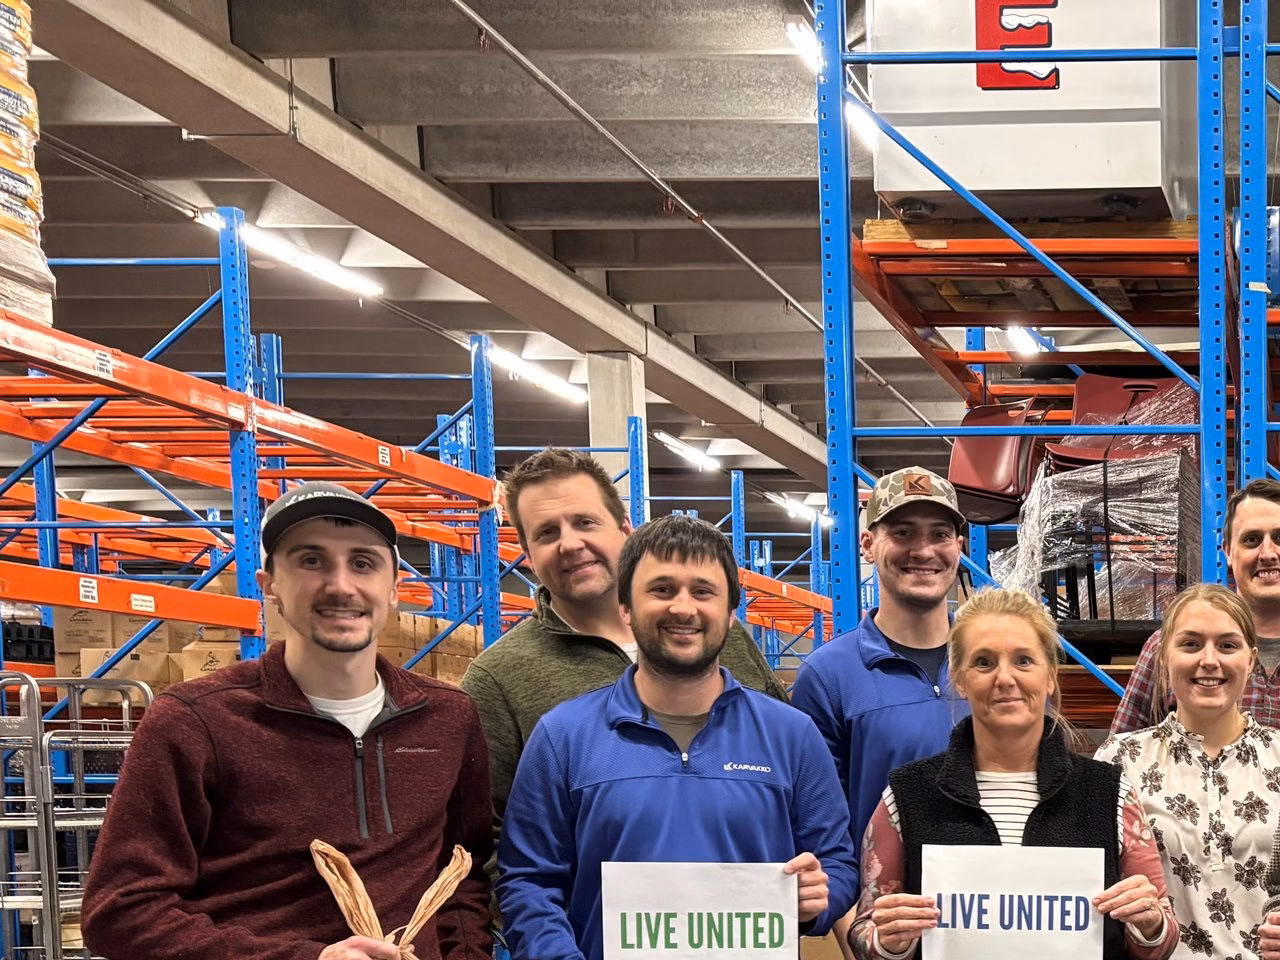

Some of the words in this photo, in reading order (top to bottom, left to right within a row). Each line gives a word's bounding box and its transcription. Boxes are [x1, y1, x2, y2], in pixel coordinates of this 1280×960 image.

[620, 912, 679, 949] LIVE
[687, 912, 785, 949] UNITED
[936, 893, 990, 930] LIVE
[999, 894, 1090, 931] UNITED
